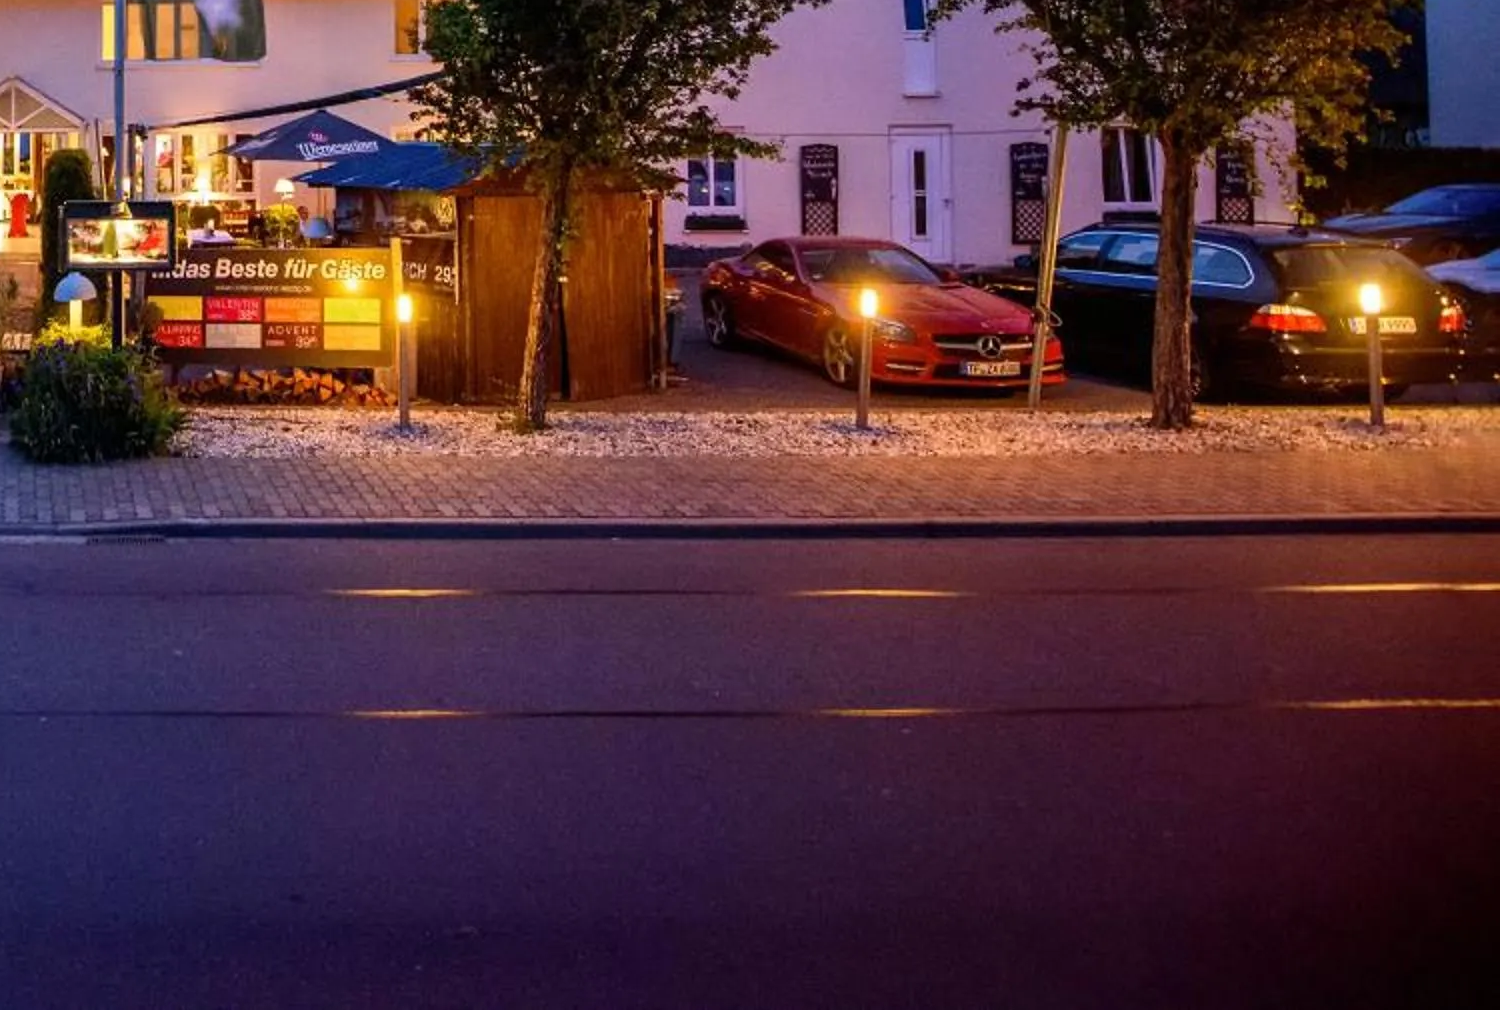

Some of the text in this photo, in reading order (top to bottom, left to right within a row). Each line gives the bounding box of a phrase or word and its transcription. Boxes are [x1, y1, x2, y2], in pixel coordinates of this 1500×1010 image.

[215, 259, 279, 279] Beste
[284, 259, 319, 279] für
[321, 259, 385, 279] Gäste
[267, 325, 317, 335] ADVENT
